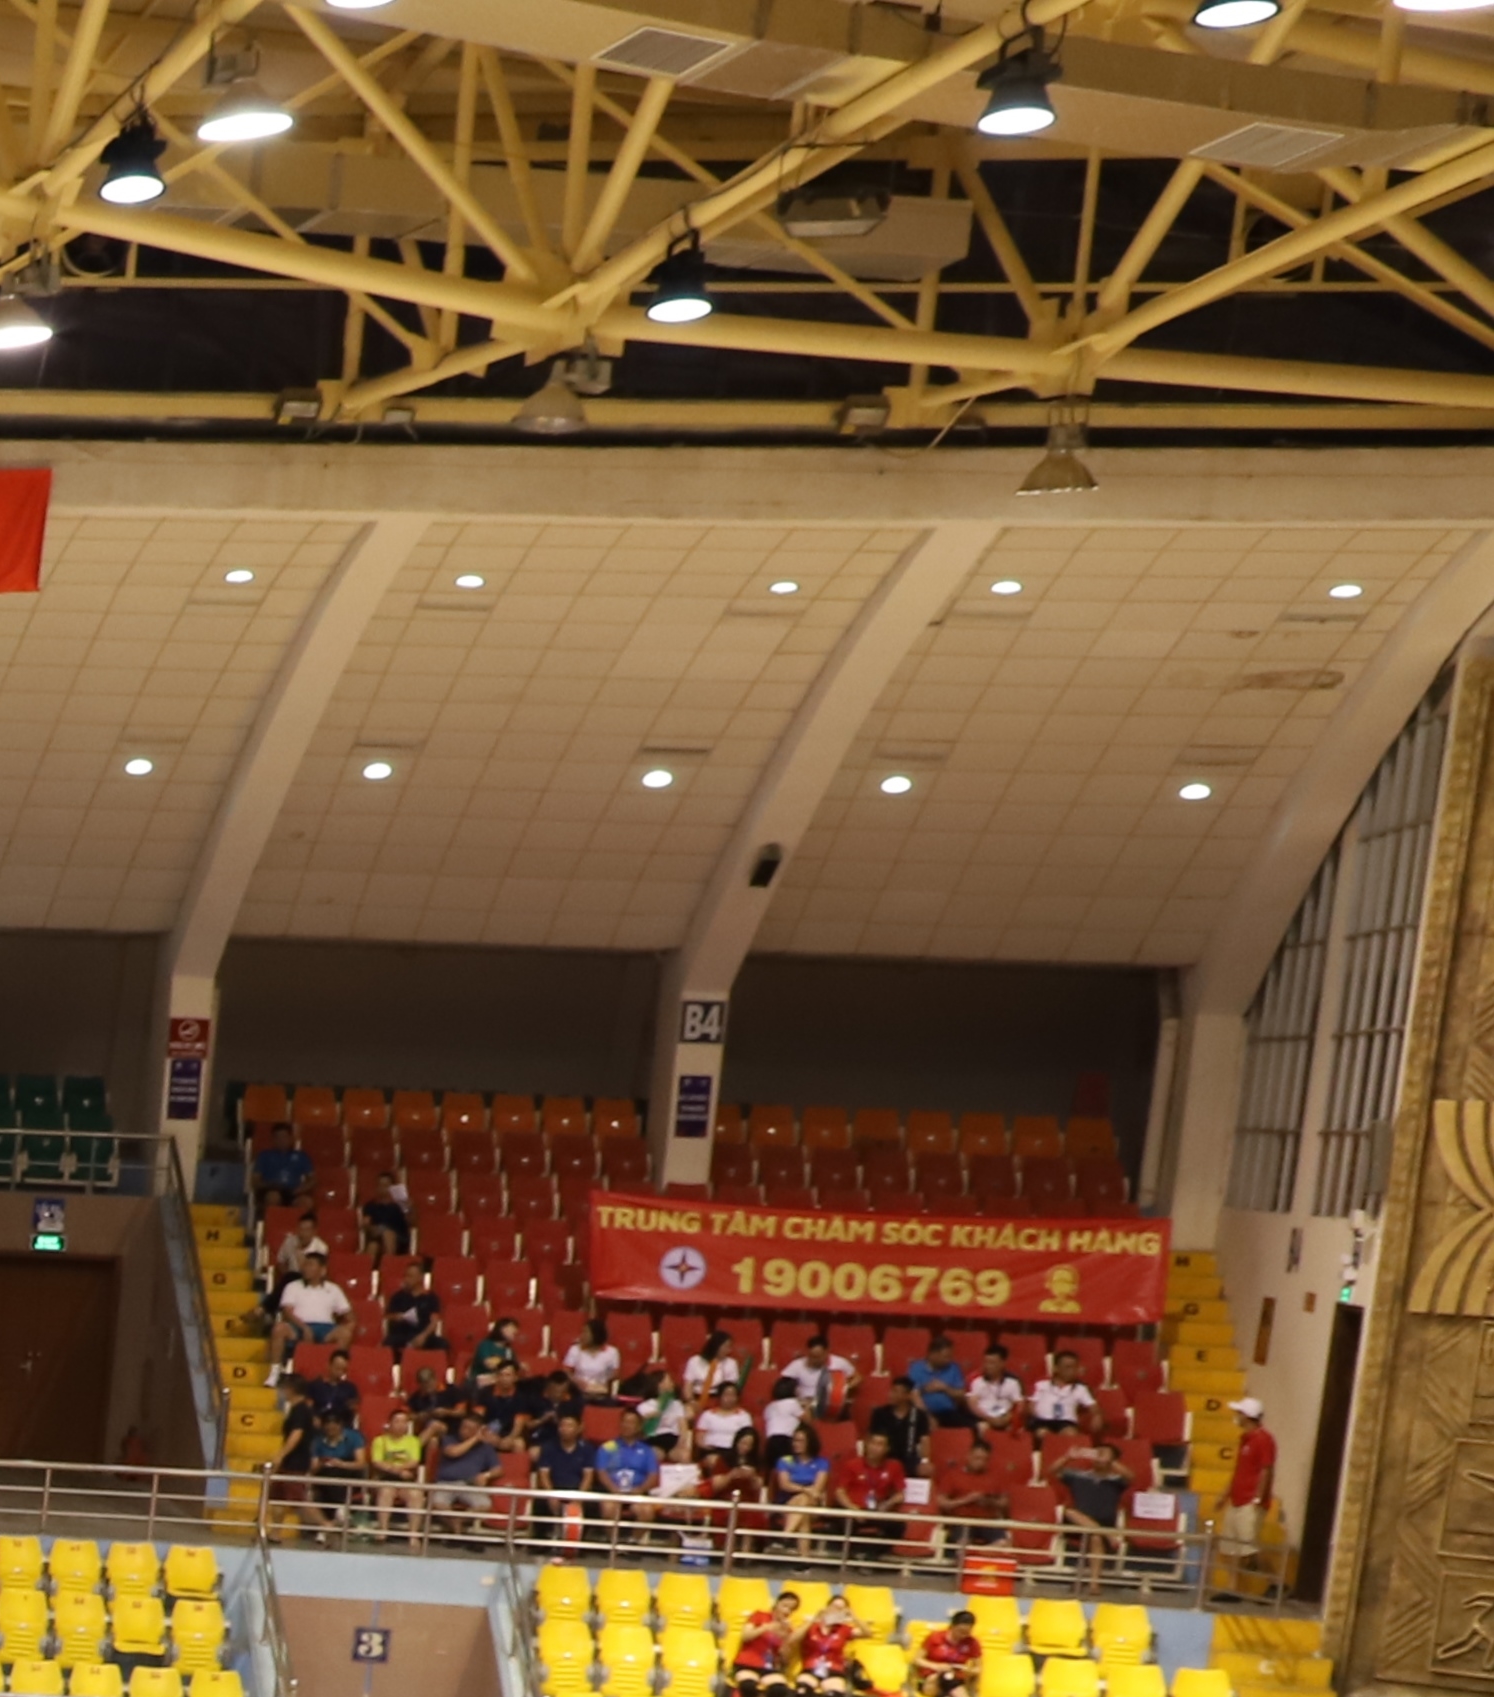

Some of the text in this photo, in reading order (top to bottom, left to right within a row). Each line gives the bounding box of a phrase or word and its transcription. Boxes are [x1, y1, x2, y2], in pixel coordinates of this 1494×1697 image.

[684, 1003, 721, 1041] B4
[597, 1206, 701, 1235] TRUNG
[712, 1210, 778, 1240] TÂM
[881, 1217, 944, 1248] SÓC
[950, 1221, 1059, 1253] KHÁCH
[1067, 1225, 1161, 1256] HÀNG
[732, 1256, 1012, 1307] 19006769
[359, 1633, 384, 1657] 3
